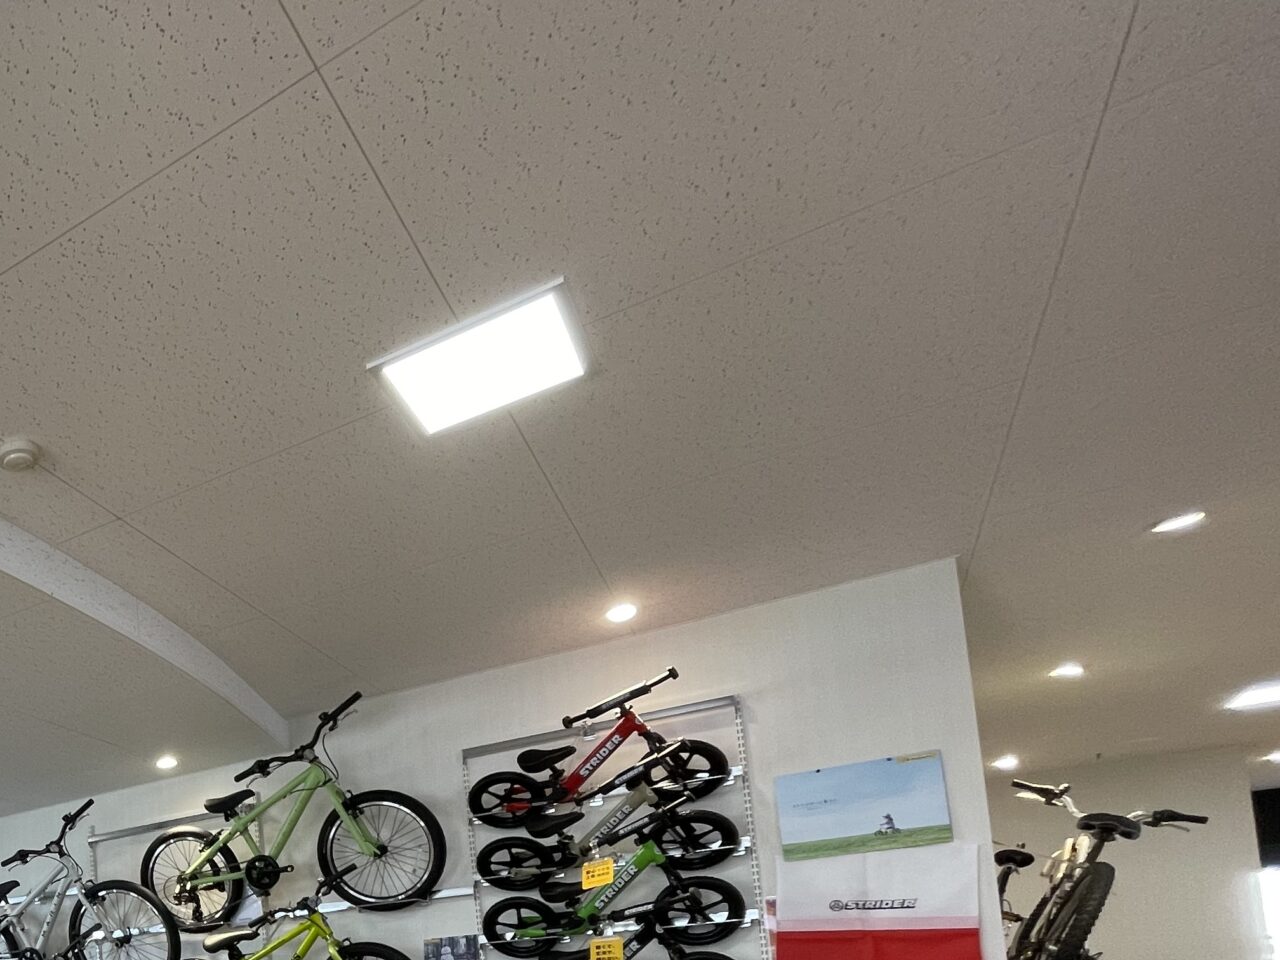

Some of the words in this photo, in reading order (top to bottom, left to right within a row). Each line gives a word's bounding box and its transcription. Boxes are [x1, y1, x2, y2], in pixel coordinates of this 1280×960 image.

[579, 734, 623, 778] STRIDER
[594, 864, 639, 911] STRIDER
[843, 899, 918, 910] STRIDER
